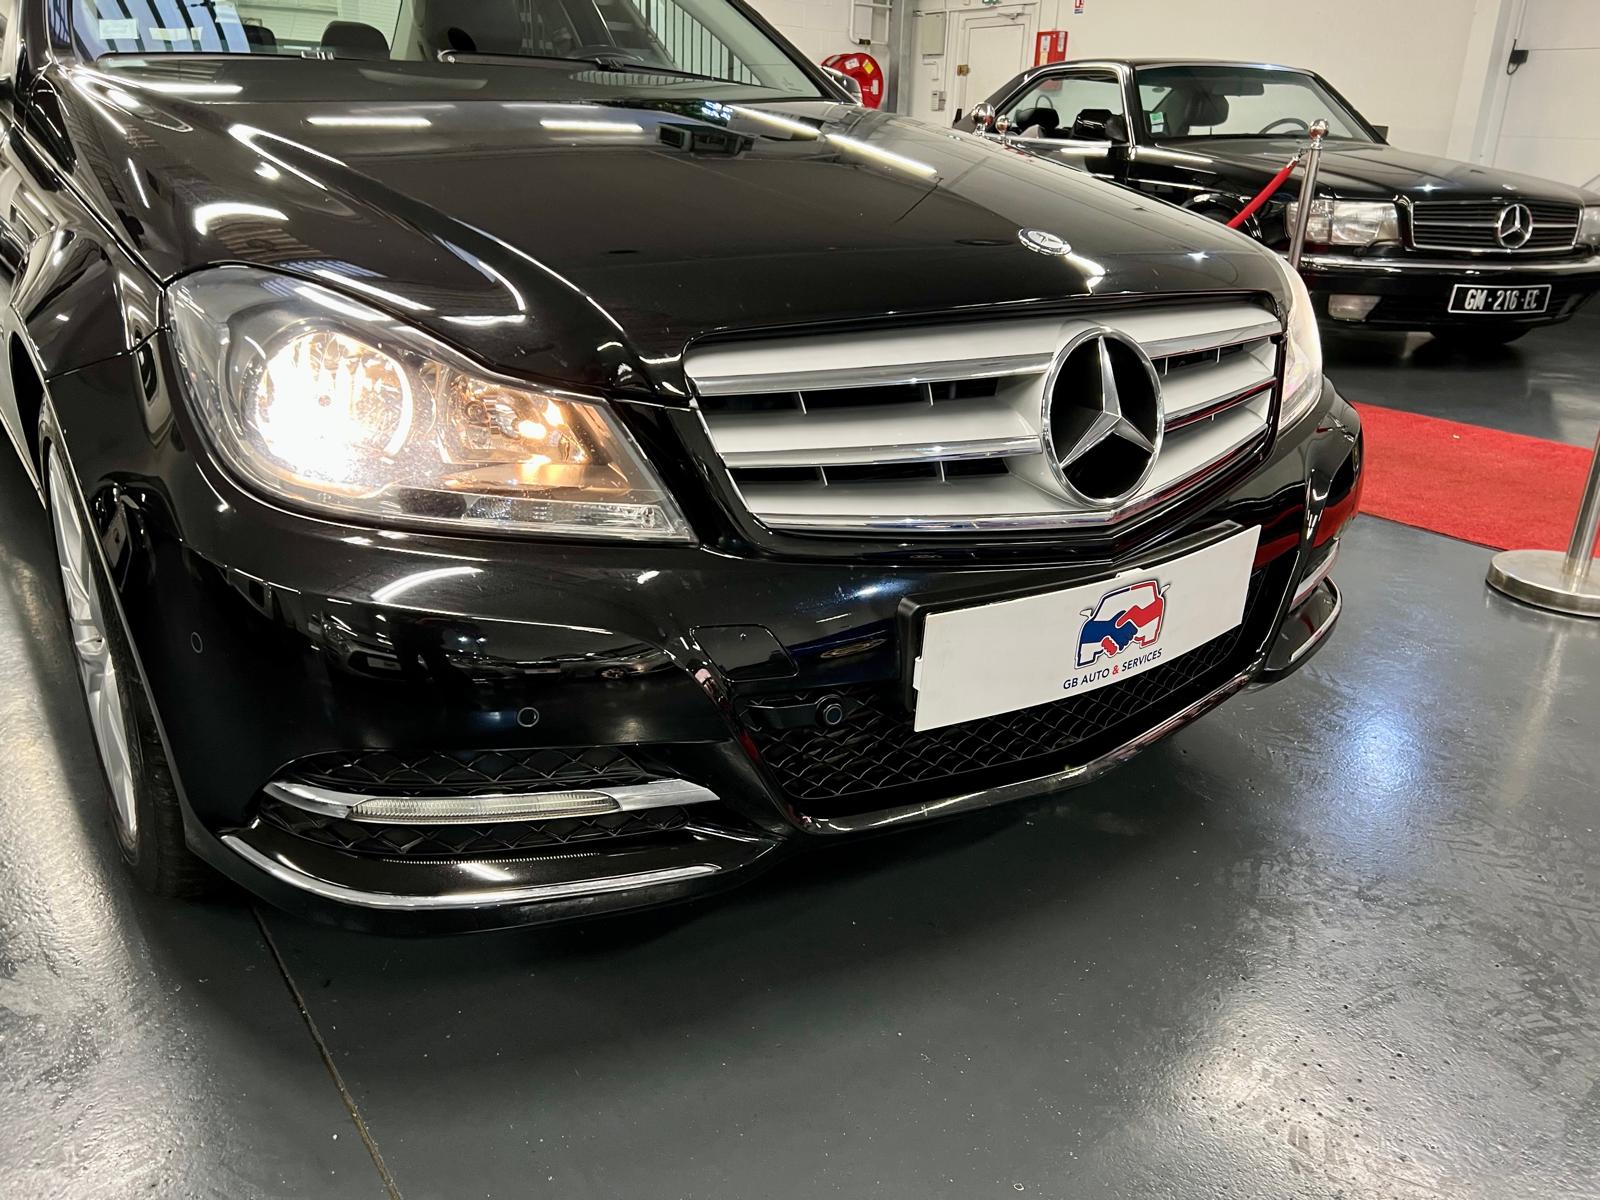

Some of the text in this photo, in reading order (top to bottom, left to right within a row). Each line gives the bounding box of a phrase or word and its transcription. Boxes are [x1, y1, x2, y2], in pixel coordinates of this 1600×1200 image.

[1063, 648, 1162, 690] GB AUTO & SERVICES
